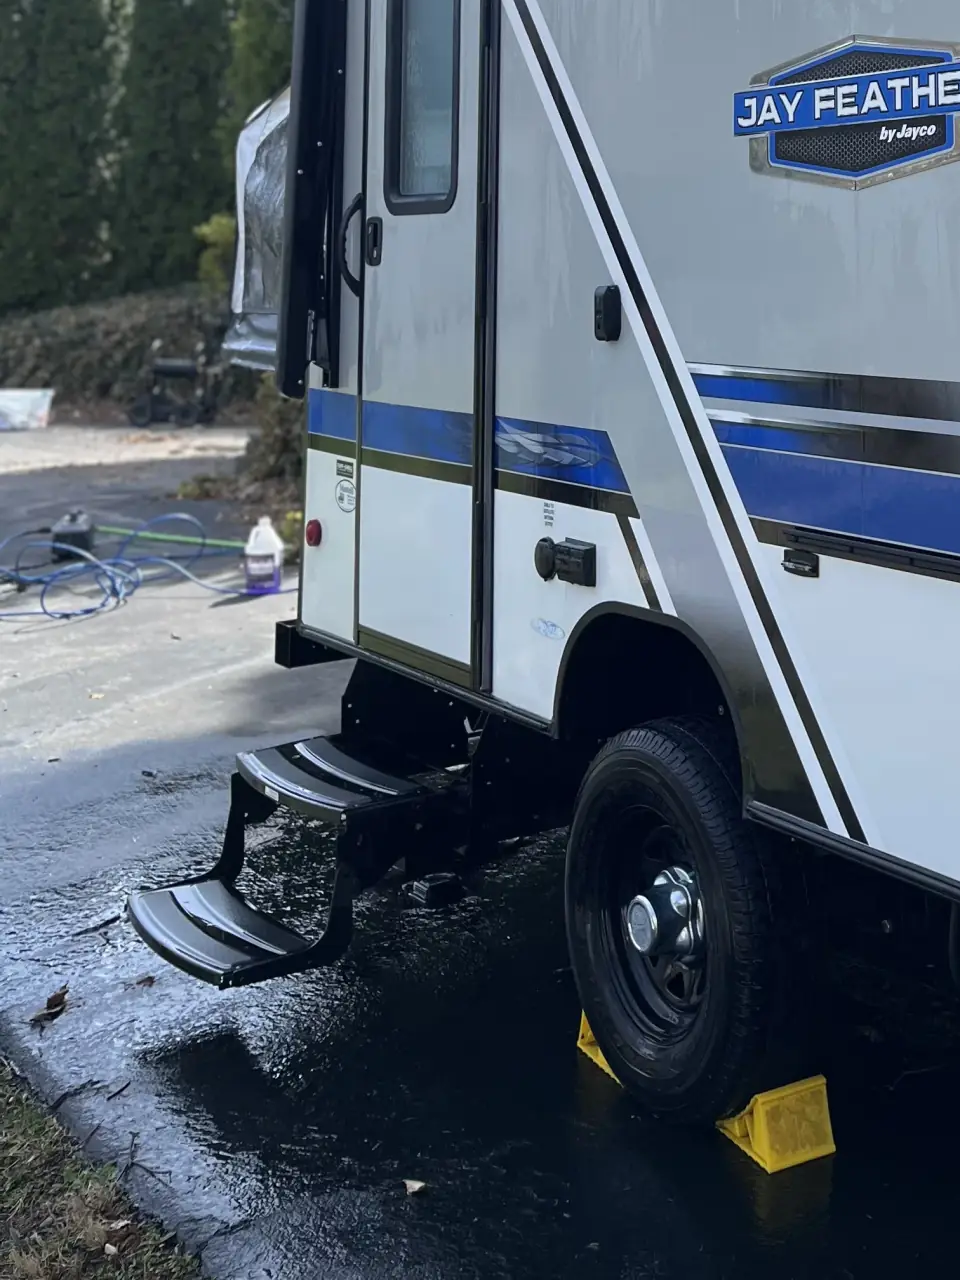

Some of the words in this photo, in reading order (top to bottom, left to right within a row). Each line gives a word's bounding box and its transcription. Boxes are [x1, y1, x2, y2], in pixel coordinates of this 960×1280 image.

[737, 91, 804, 128] JAY
[879, 126, 897, 143] by
[896, 123, 937, 142] Jayco
